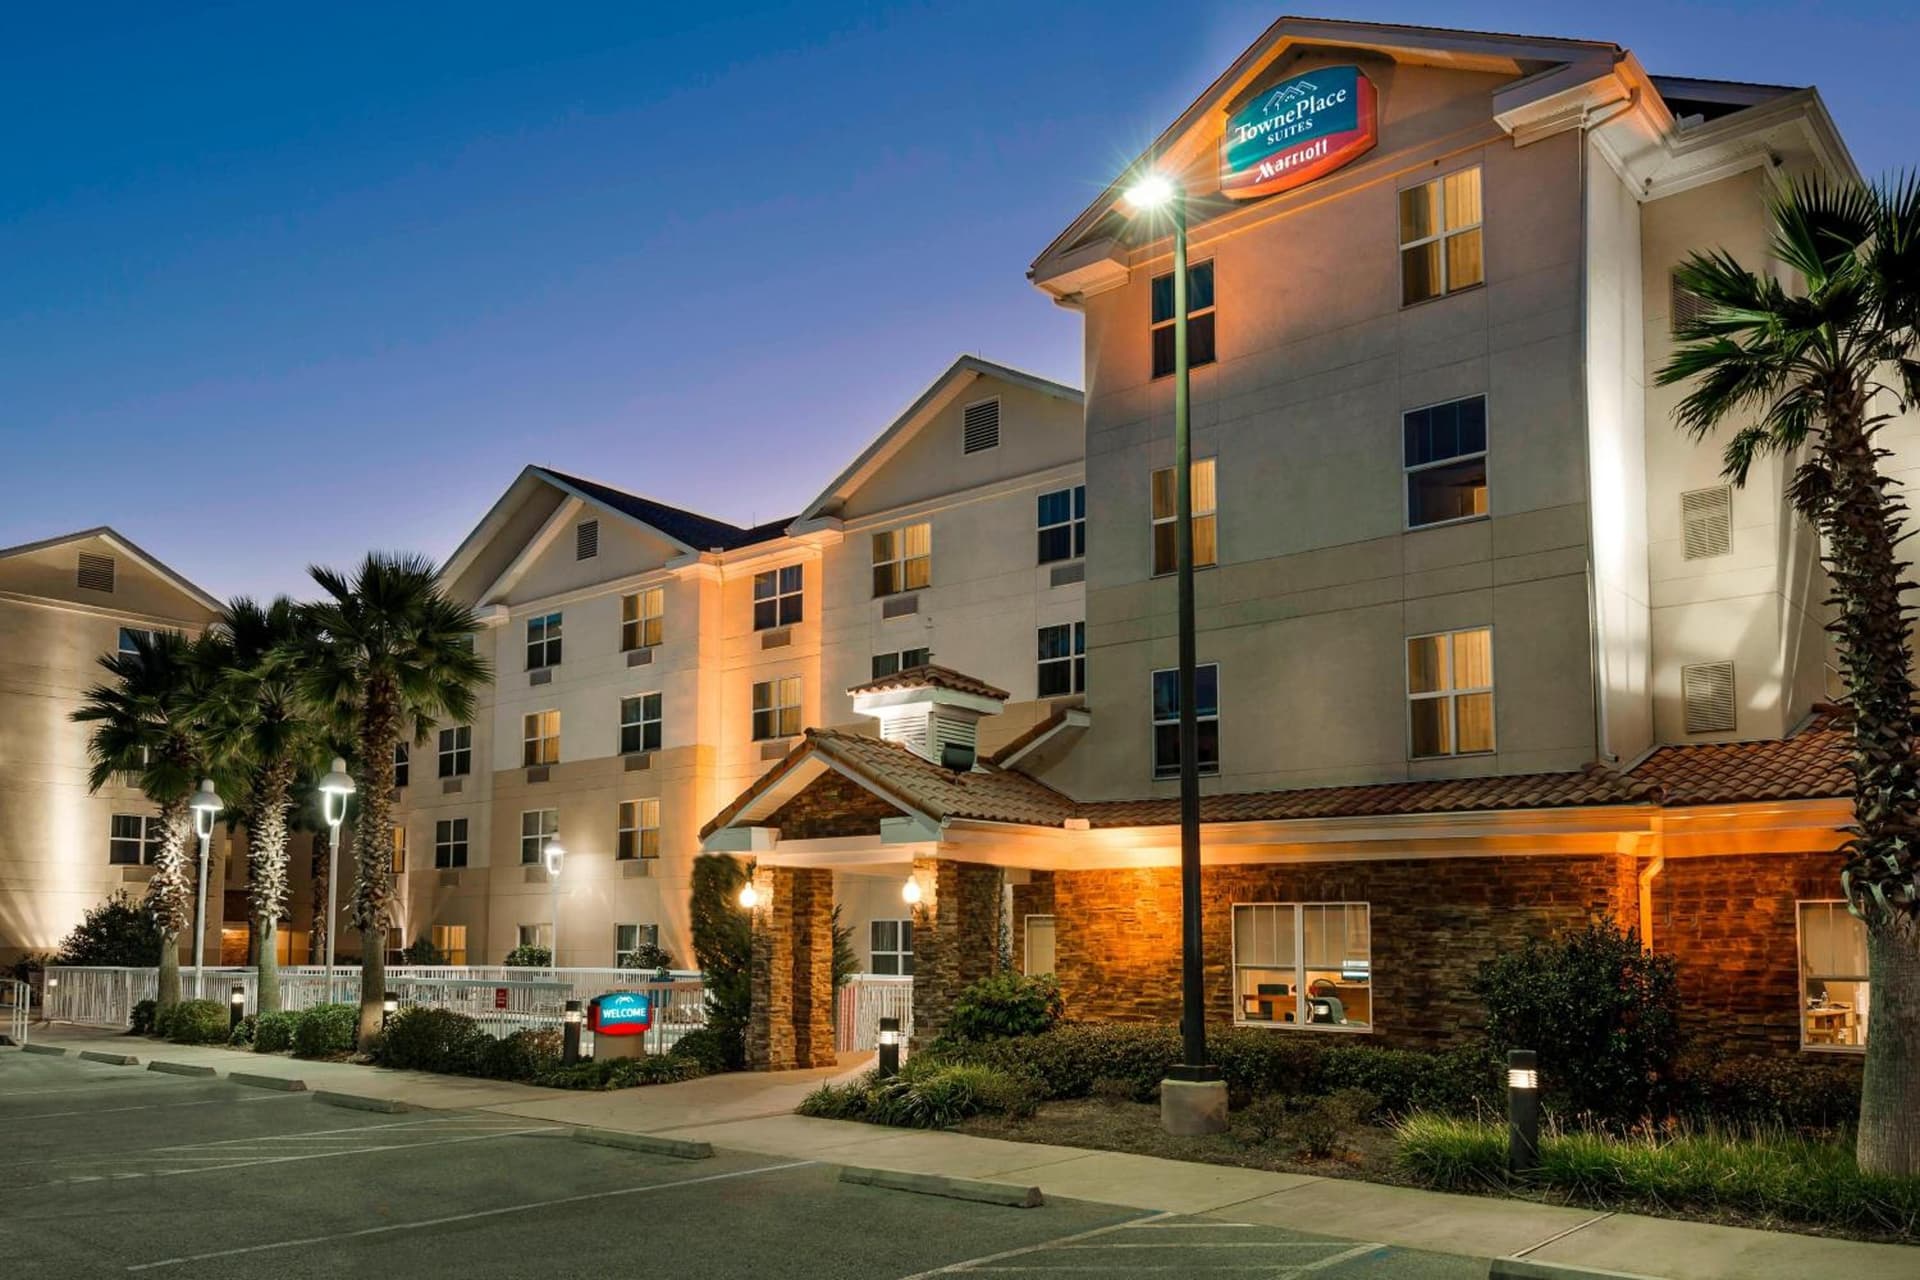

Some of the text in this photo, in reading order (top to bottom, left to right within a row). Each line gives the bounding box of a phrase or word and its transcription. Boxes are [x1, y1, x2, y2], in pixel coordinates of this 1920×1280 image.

[1235, 89, 1347, 143] TownePlace
[1267, 119, 1313, 145] SUITES
[1256, 139, 1328, 183] Marriott
[602, 1007, 647, 1019] WELCOME
